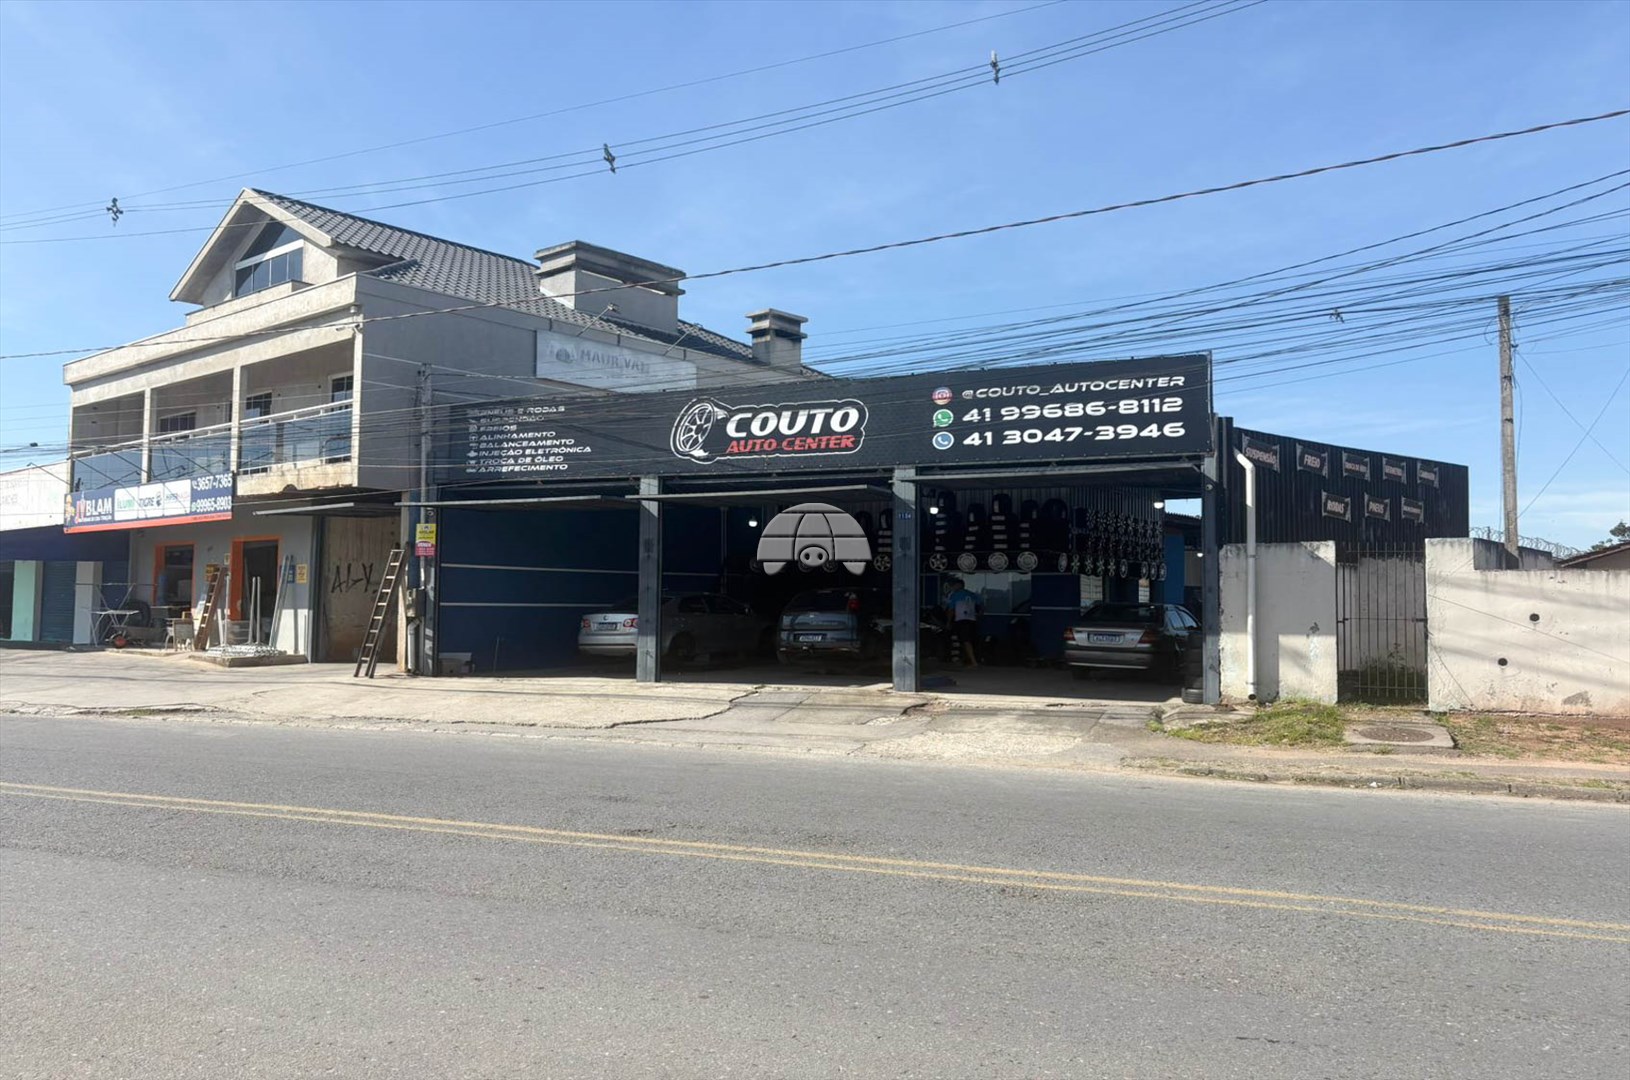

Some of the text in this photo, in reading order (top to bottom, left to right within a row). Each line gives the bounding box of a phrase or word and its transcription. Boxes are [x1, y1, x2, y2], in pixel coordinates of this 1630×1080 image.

[962, 376, 1185, 399] @COUTO_AUTOCENTER
[962, 397, 1183, 422] 41 99686-8112
[726, 406, 859, 438] COUTO
[479, 431, 556, 441] ALINHAMENTO
[962, 422, 1186, 446] 41 3047-3946
[479, 439, 575, 449] BALANCEAMENTO
[524, 446, 592, 455] ELETRÔNICA
[726, 435, 855, 454] AUTO CENTER
[480, 457, 515, 465] TROCA
[478, 464, 569, 473] ARREFECIMENTO
